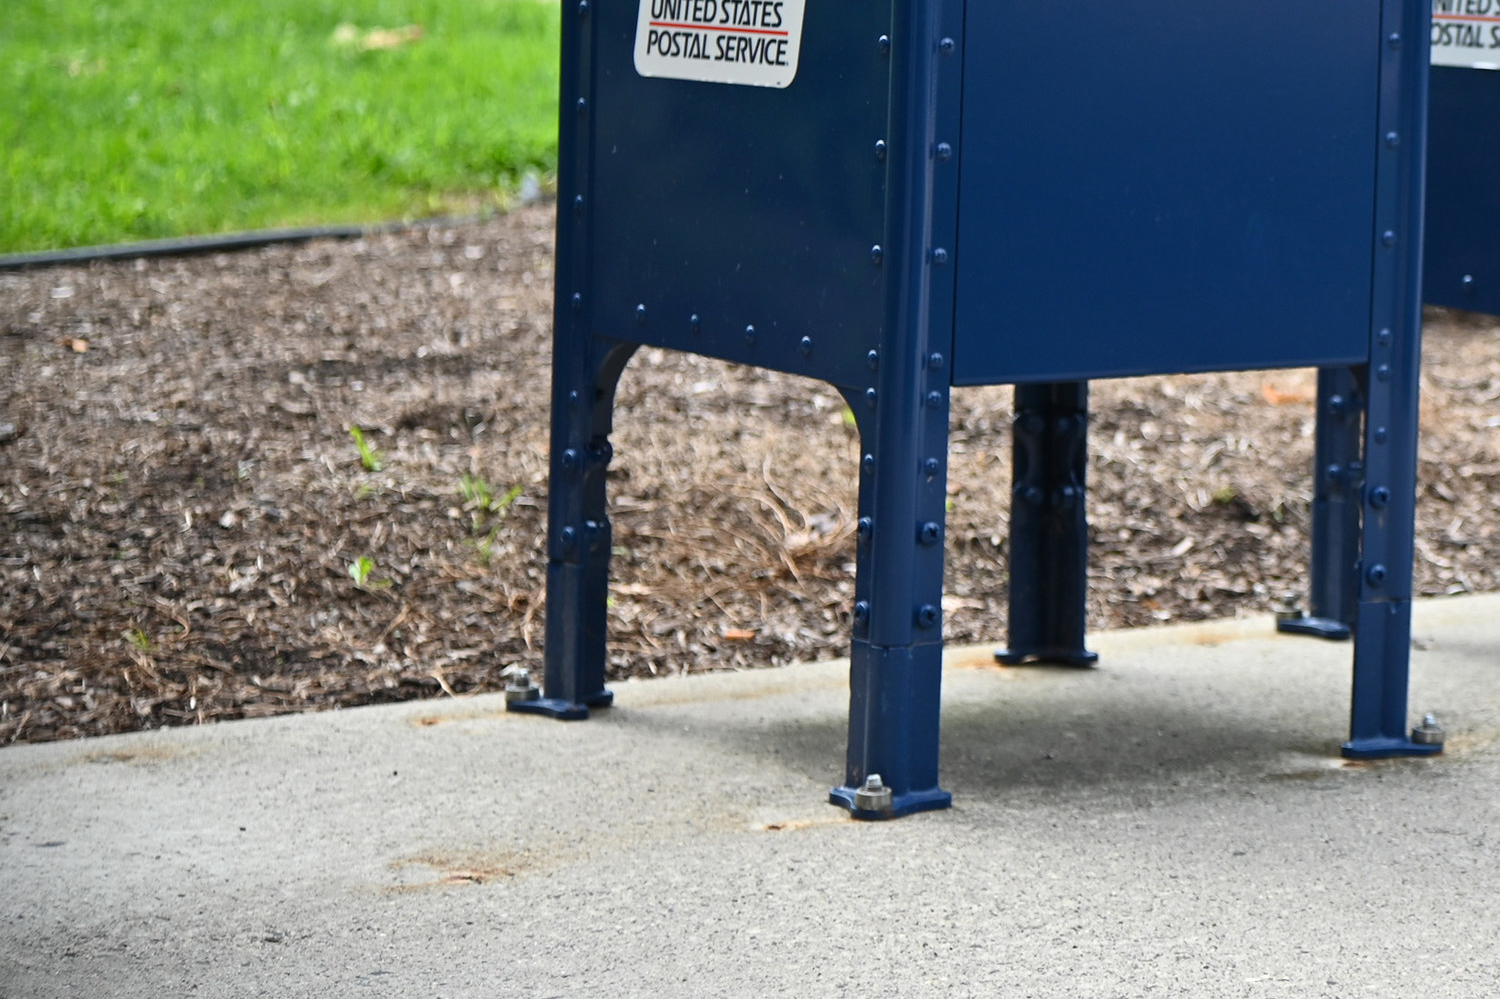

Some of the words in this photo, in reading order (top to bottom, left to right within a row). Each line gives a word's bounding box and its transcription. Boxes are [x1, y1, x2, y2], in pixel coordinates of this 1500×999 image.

[646, 29, 711, 60] POSTAL
[714, 34, 789, 66] SERVICE
[1431, 23, 1485, 48] OSTAL
